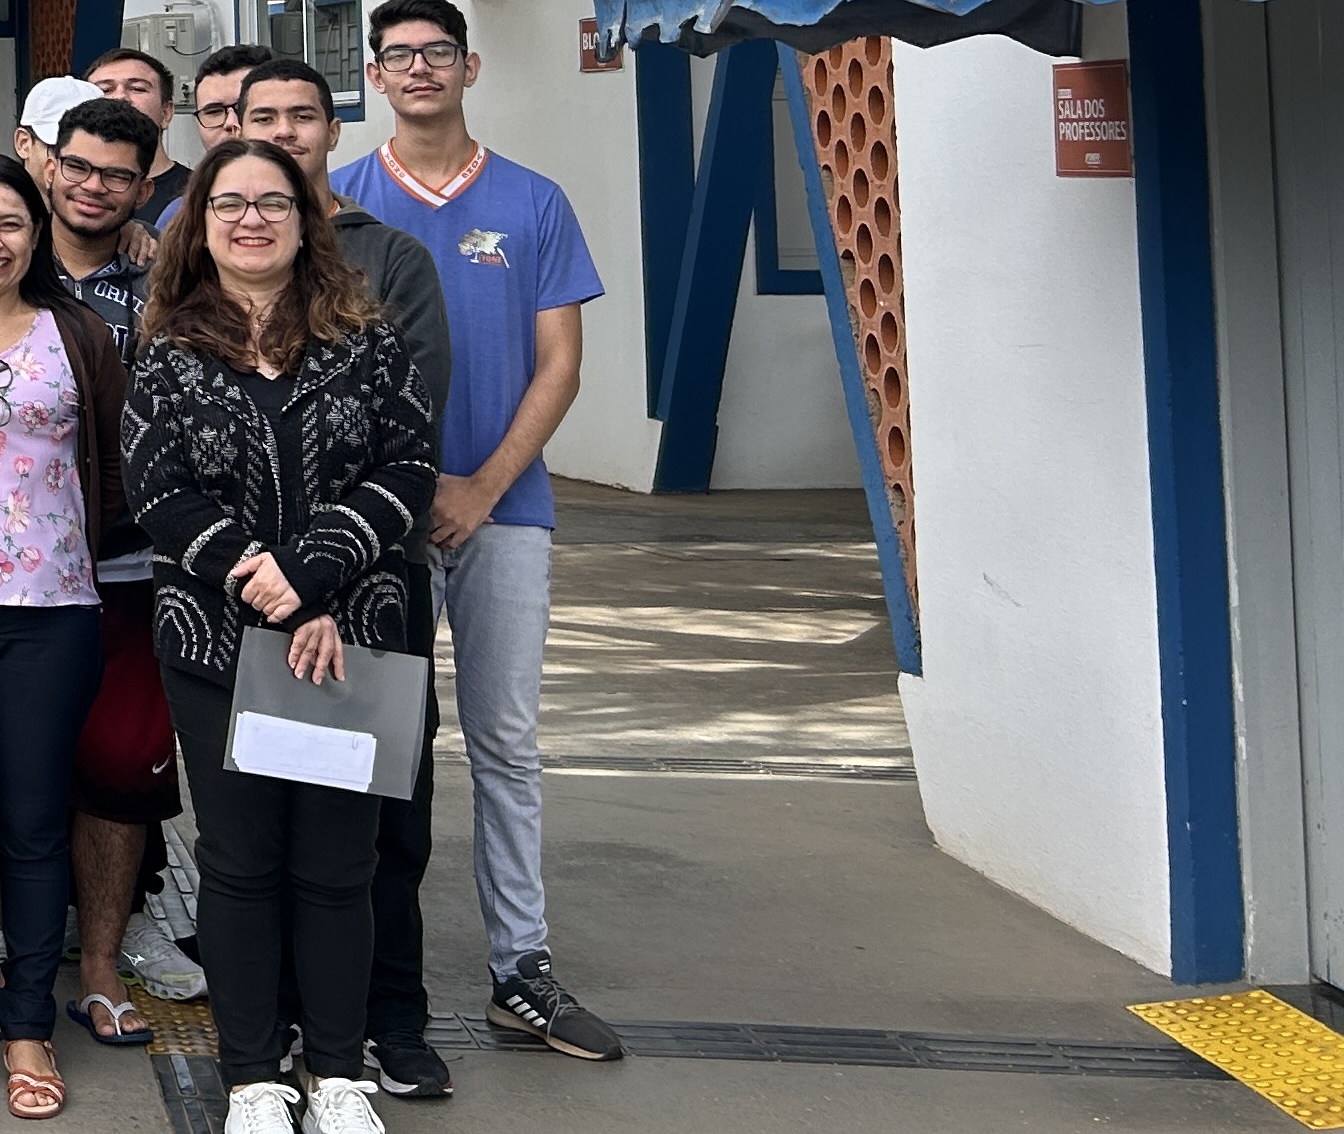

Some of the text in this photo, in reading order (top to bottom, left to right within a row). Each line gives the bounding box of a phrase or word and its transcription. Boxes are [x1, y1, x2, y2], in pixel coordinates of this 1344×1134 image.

[1058, 98, 1105, 119] SALA DOS
[1059, 121, 1127, 141] PROFESSORES
